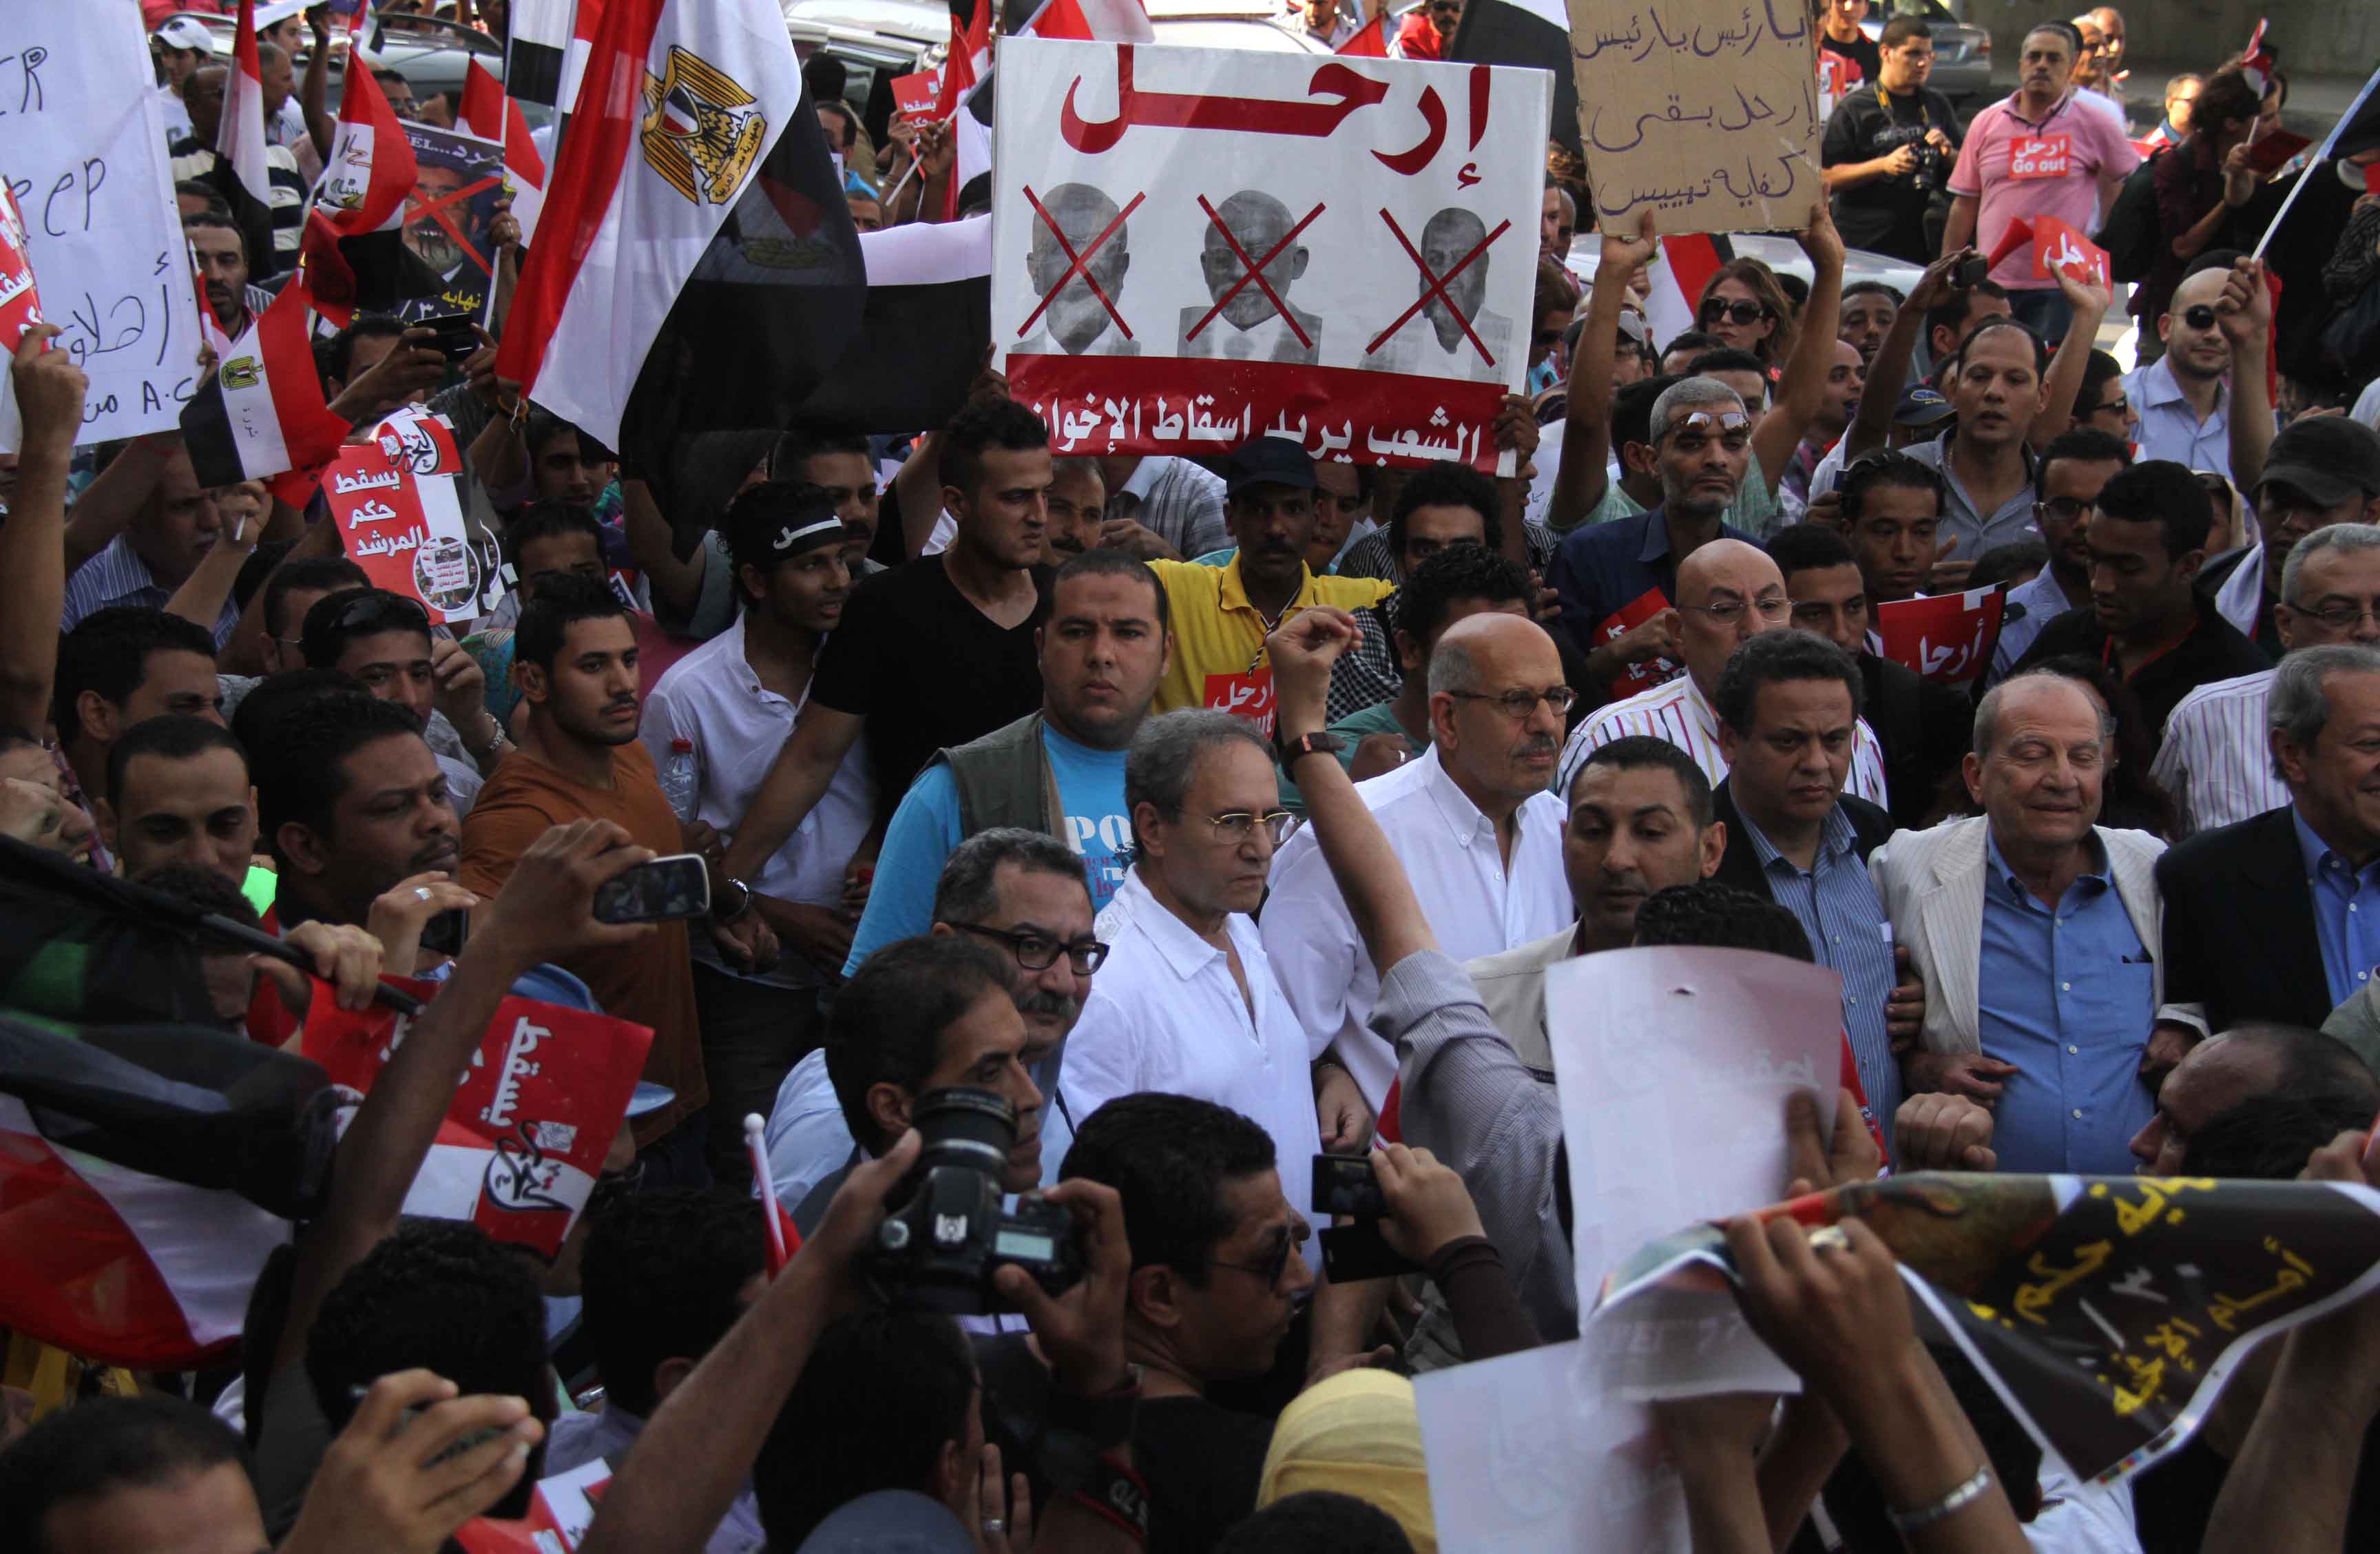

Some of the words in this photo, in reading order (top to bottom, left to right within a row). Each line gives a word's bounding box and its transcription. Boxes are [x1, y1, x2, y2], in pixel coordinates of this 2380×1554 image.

[1061, 43, 1492, 190] إرحل
[2012, 159, 2035, 174] Go
[2039, 158, 2066, 172] out
[1367, 405, 1481, 468] الشعب
[335, 468, 401, 495] يسقط
[348, 499, 397, 530] حكم
[355, 524, 425, 557] المرشد
